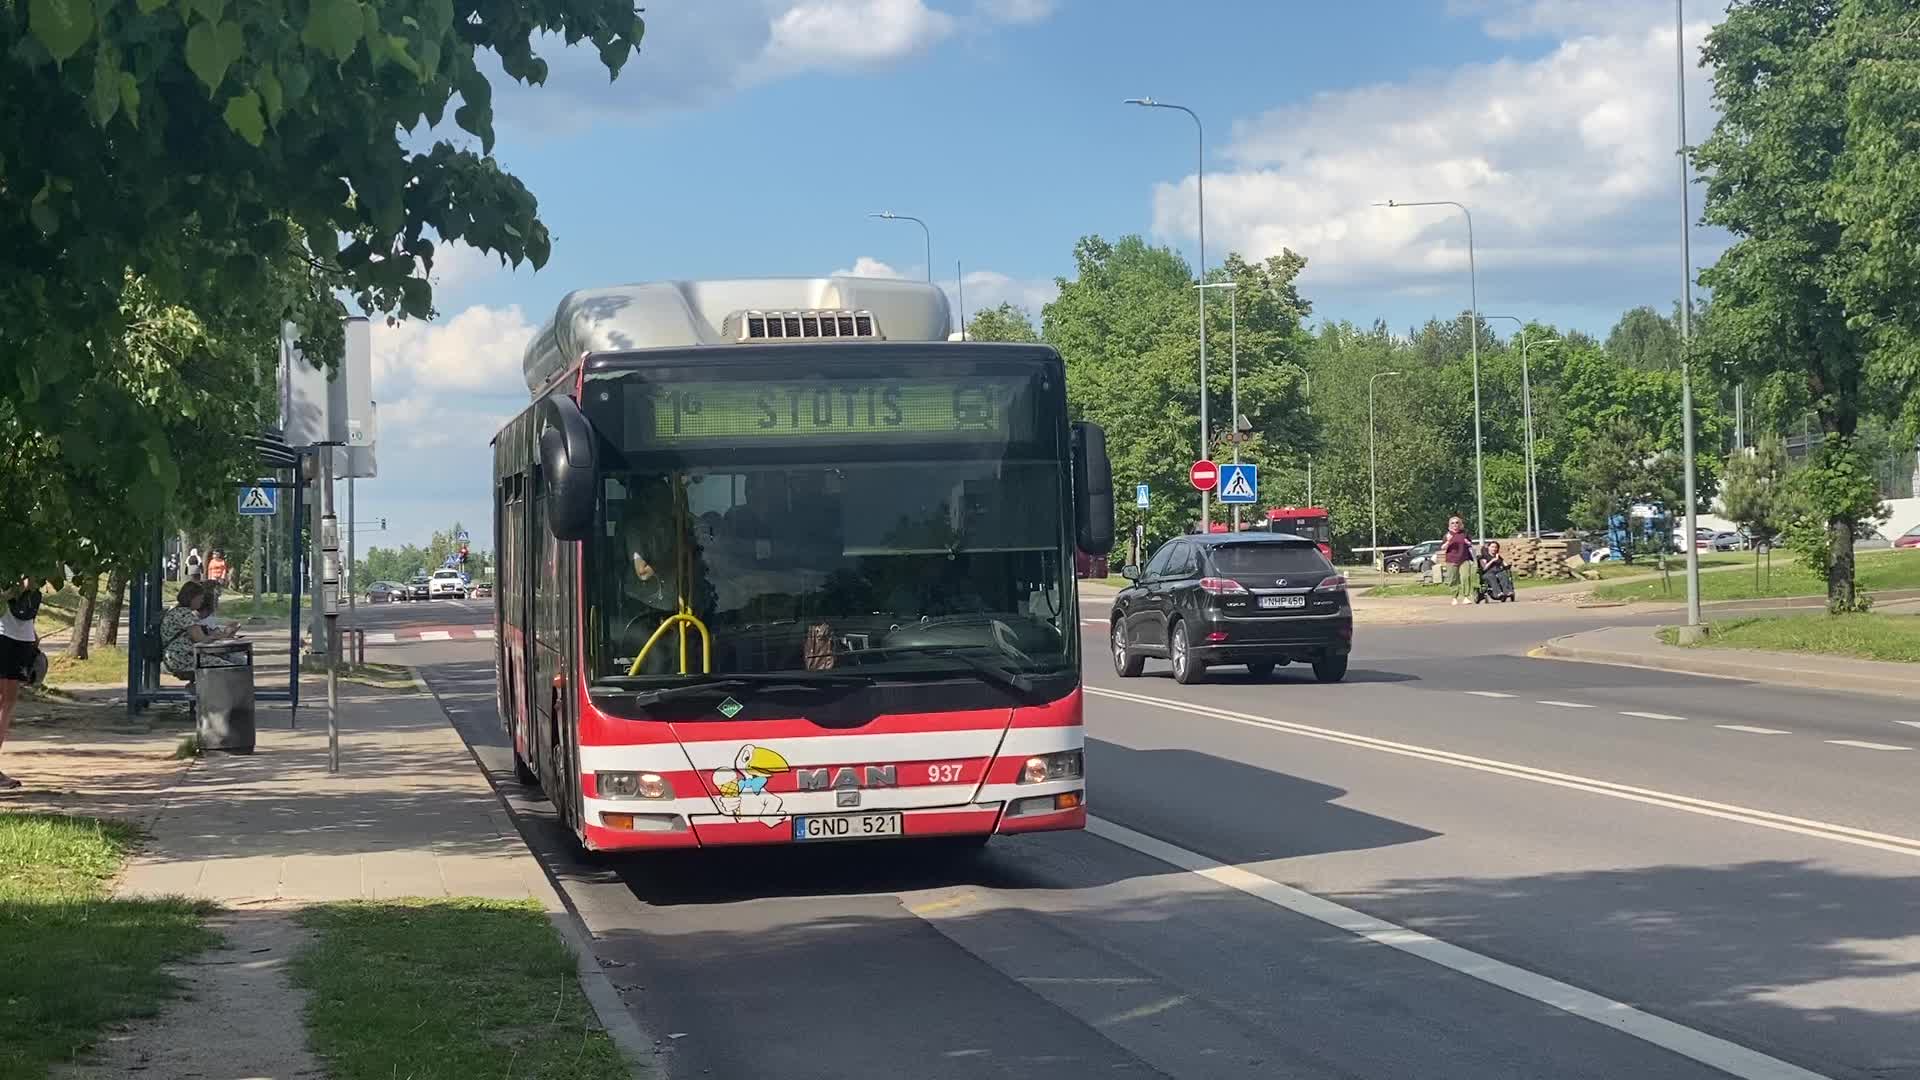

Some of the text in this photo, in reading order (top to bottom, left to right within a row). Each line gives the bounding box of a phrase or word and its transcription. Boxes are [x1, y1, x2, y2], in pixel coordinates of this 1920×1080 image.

[757, 388, 902, 428] STOTIS
[797, 765, 896, 790] MAN
[928, 764, 963, 782] 937
[808, 818, 849, 836] GND
[863, 815, 896, 833] 521
